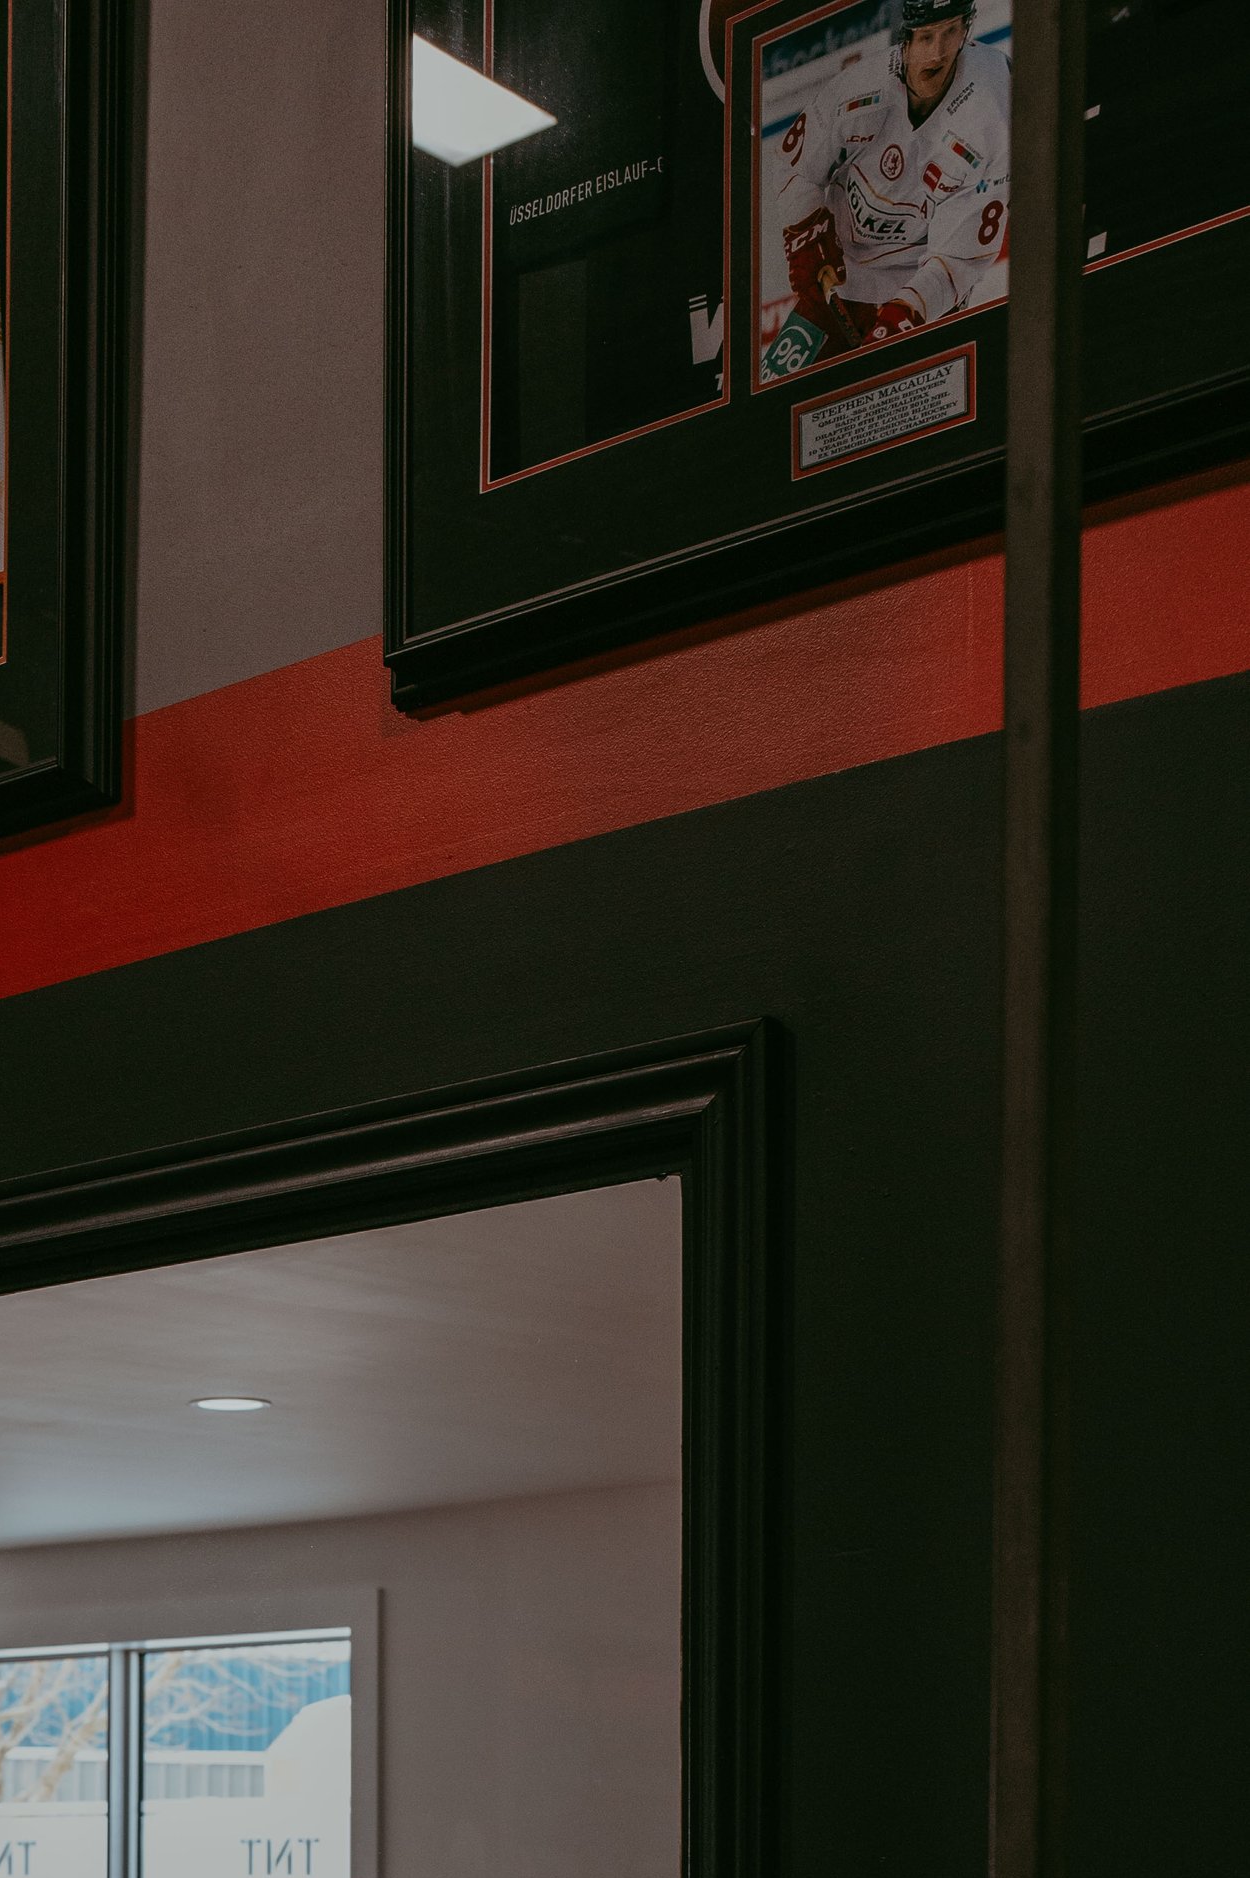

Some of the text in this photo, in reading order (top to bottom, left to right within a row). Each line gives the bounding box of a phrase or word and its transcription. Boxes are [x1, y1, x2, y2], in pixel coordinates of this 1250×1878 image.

[509, 180, 593, 226] ÜSSELDORFER
[811, 365, 953, 423] STEPHEN MACAULAY
